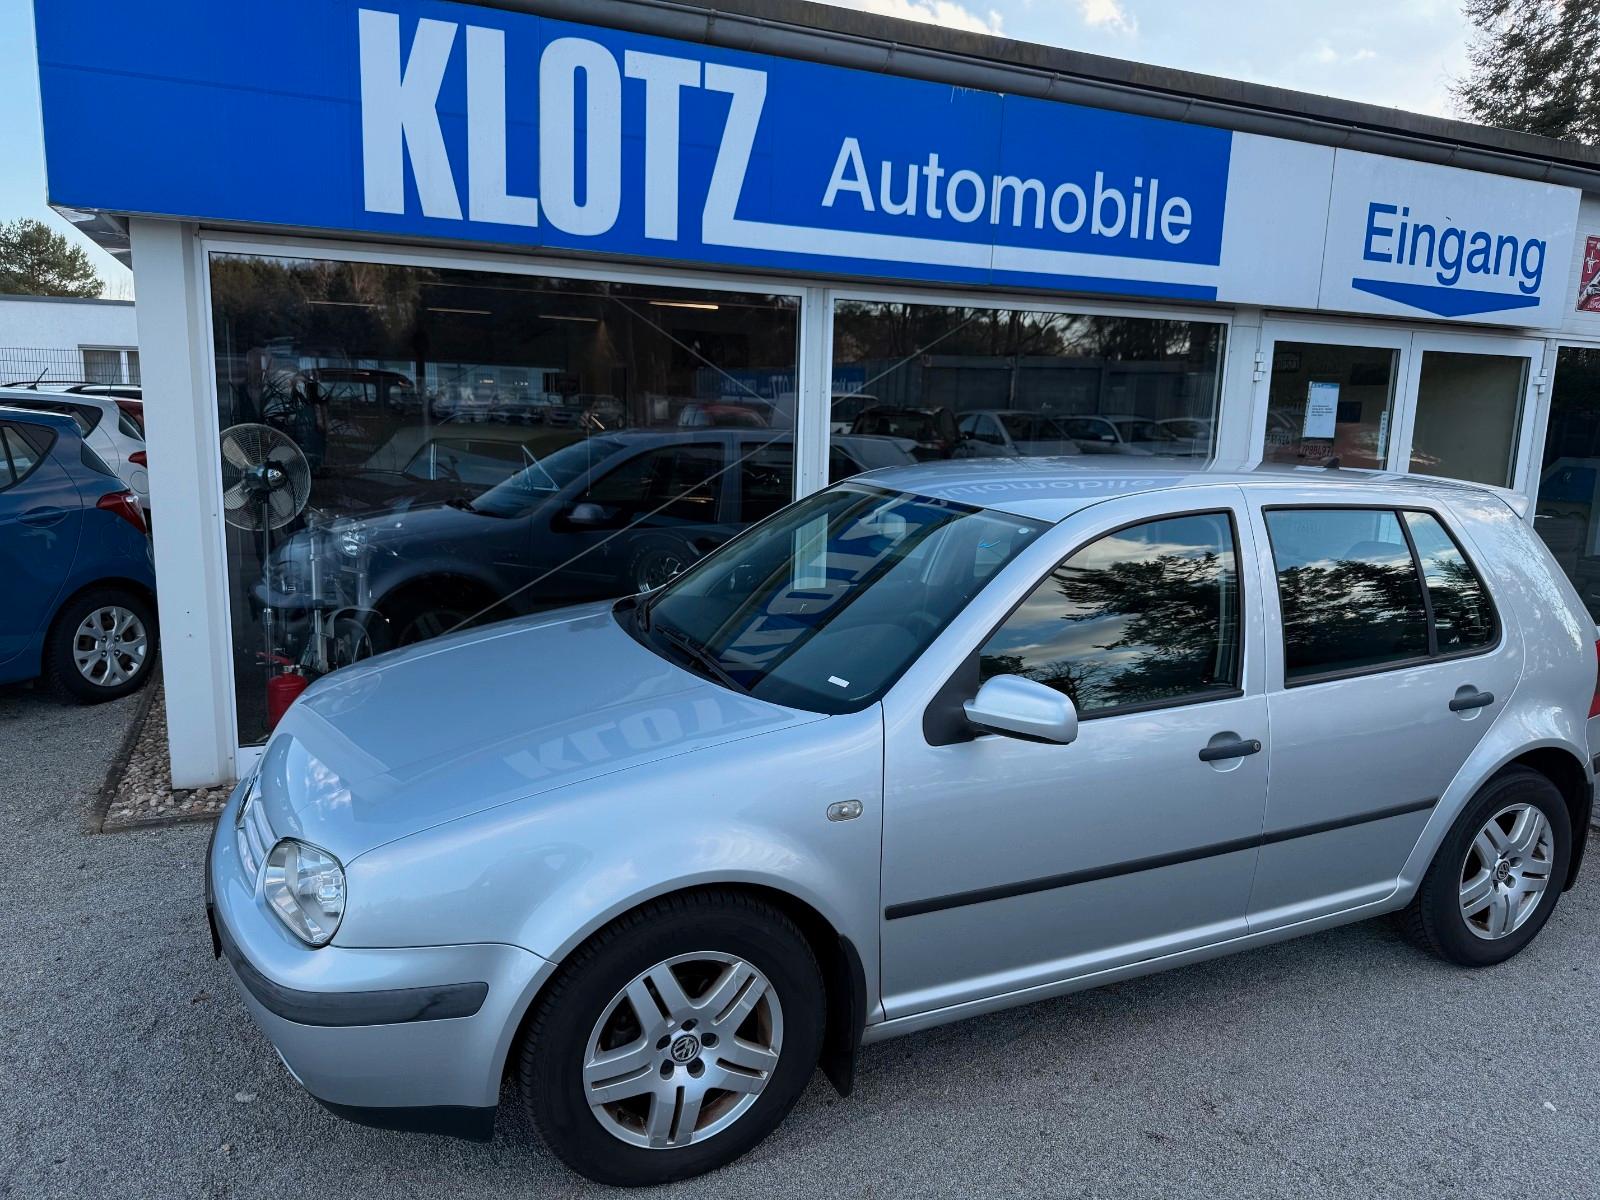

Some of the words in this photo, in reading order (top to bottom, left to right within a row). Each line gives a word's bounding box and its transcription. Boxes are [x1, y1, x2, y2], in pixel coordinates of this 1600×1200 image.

[358, 9, 768, 247] KLOTZ
[822, 137, 1193, 245] Automobile
[1364, 201, 1547, 295] Eingang
